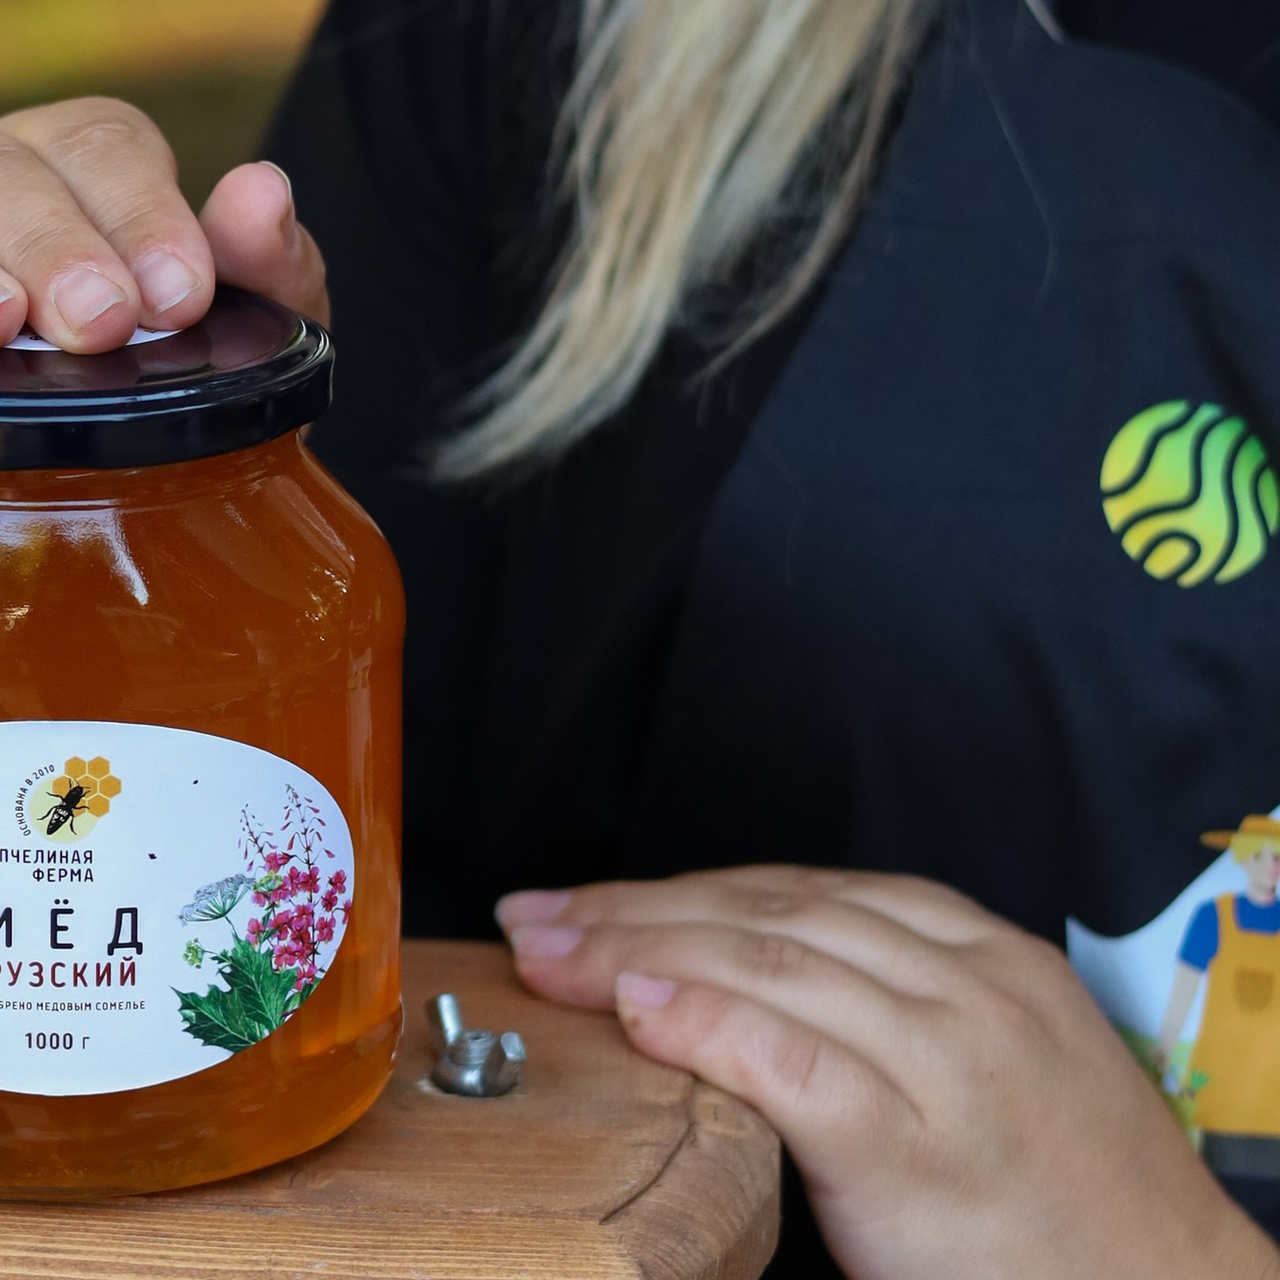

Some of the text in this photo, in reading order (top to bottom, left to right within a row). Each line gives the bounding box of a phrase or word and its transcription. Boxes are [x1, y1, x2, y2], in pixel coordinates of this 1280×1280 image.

[15, 787, 32, 837] ОСНОВАНА
[32, 764, 55, 780] 2010
[0, 848, 94, 864] ПЧЕЛИНАЯ
[32, 867, 94, 882] ФЕРМА
[36, 1001, 92, 1012] МЕДОВЫМ
[95, 1000, 146, 1011] СОМЕЛЬЕ
[25, 1032, 91, 1050] 1000 г
